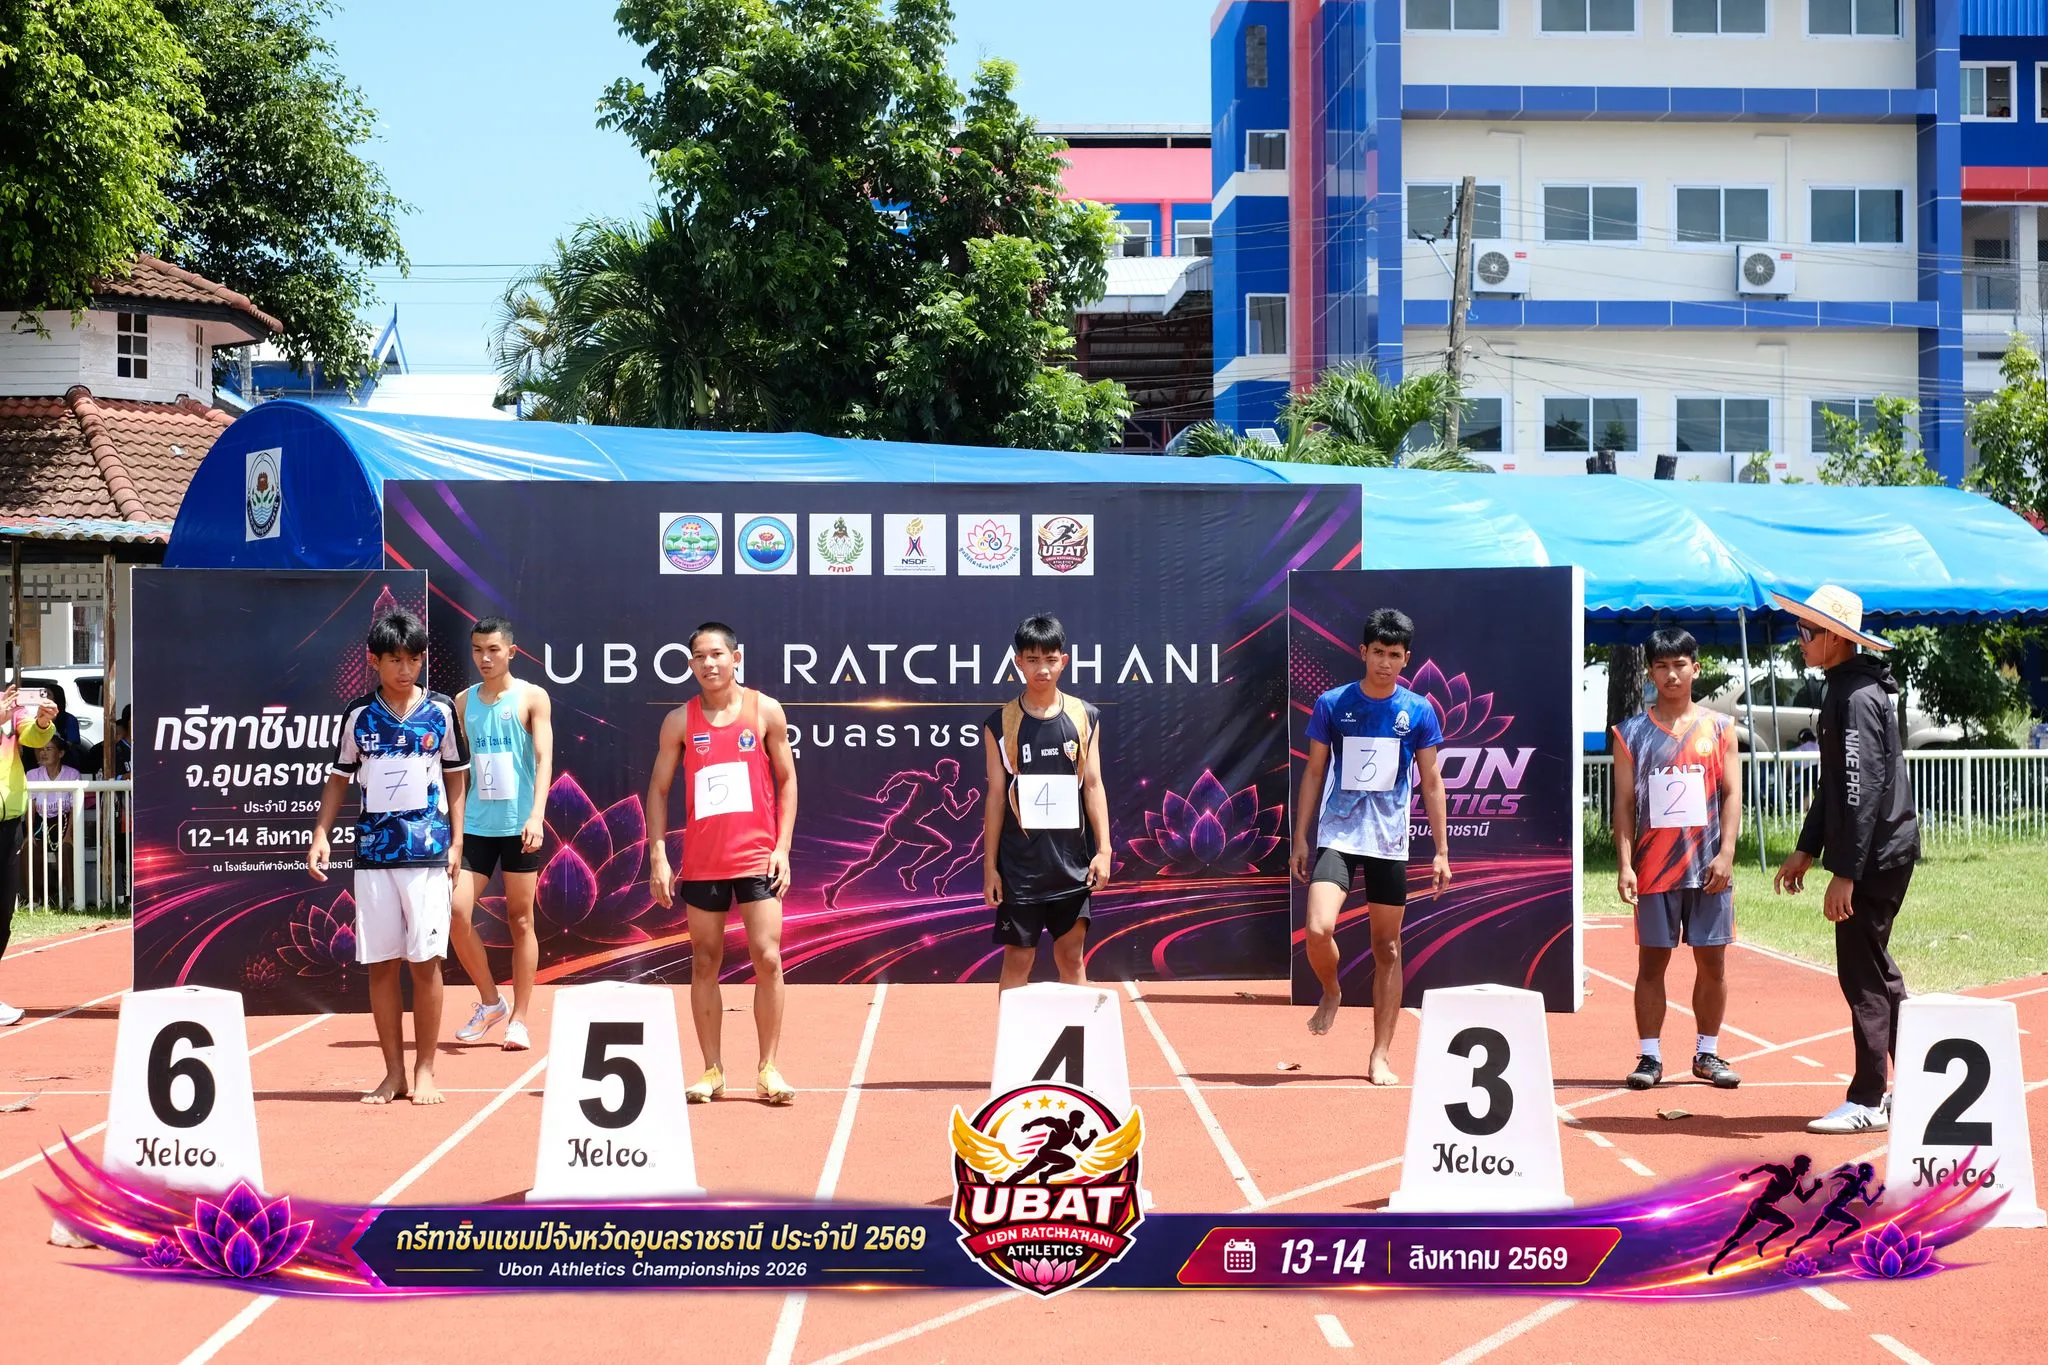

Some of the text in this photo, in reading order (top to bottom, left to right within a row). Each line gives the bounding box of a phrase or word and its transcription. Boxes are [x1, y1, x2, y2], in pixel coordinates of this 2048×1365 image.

[1042, 545, 1085, 556] UBAT
[544, 643, 1219, 684] UBO RATCHAHANI
[484, 760, 494, 787] 6
[1354, 749, 1377, 782] 3
[1845, 729, 1860, 807] NIKE PRO
[384, 769, 408, 800] 7
[707, 774, 729, 806] 5
[1034, 782, 1057, 816] 4
[1663, 780, 1687, 816] 2
[243, 799, 322, 814] ประจำปี 2569
[1031, 1025, 1085, 1088] 4
[147, 1020, 216, 1129] 6
[578, 1021, 647, 1129] 5
[1444, 1026, 1514, 1136] 3
[1922, 1038, 1993, 1146] 2
[135, 1137, 217, 1167] Nelco
[567, 1138, 648, 1168] Nelco
[1432, 1143, 1515, 1176] Nelco
[1912, 1157, 1995, 1188] Nelco
